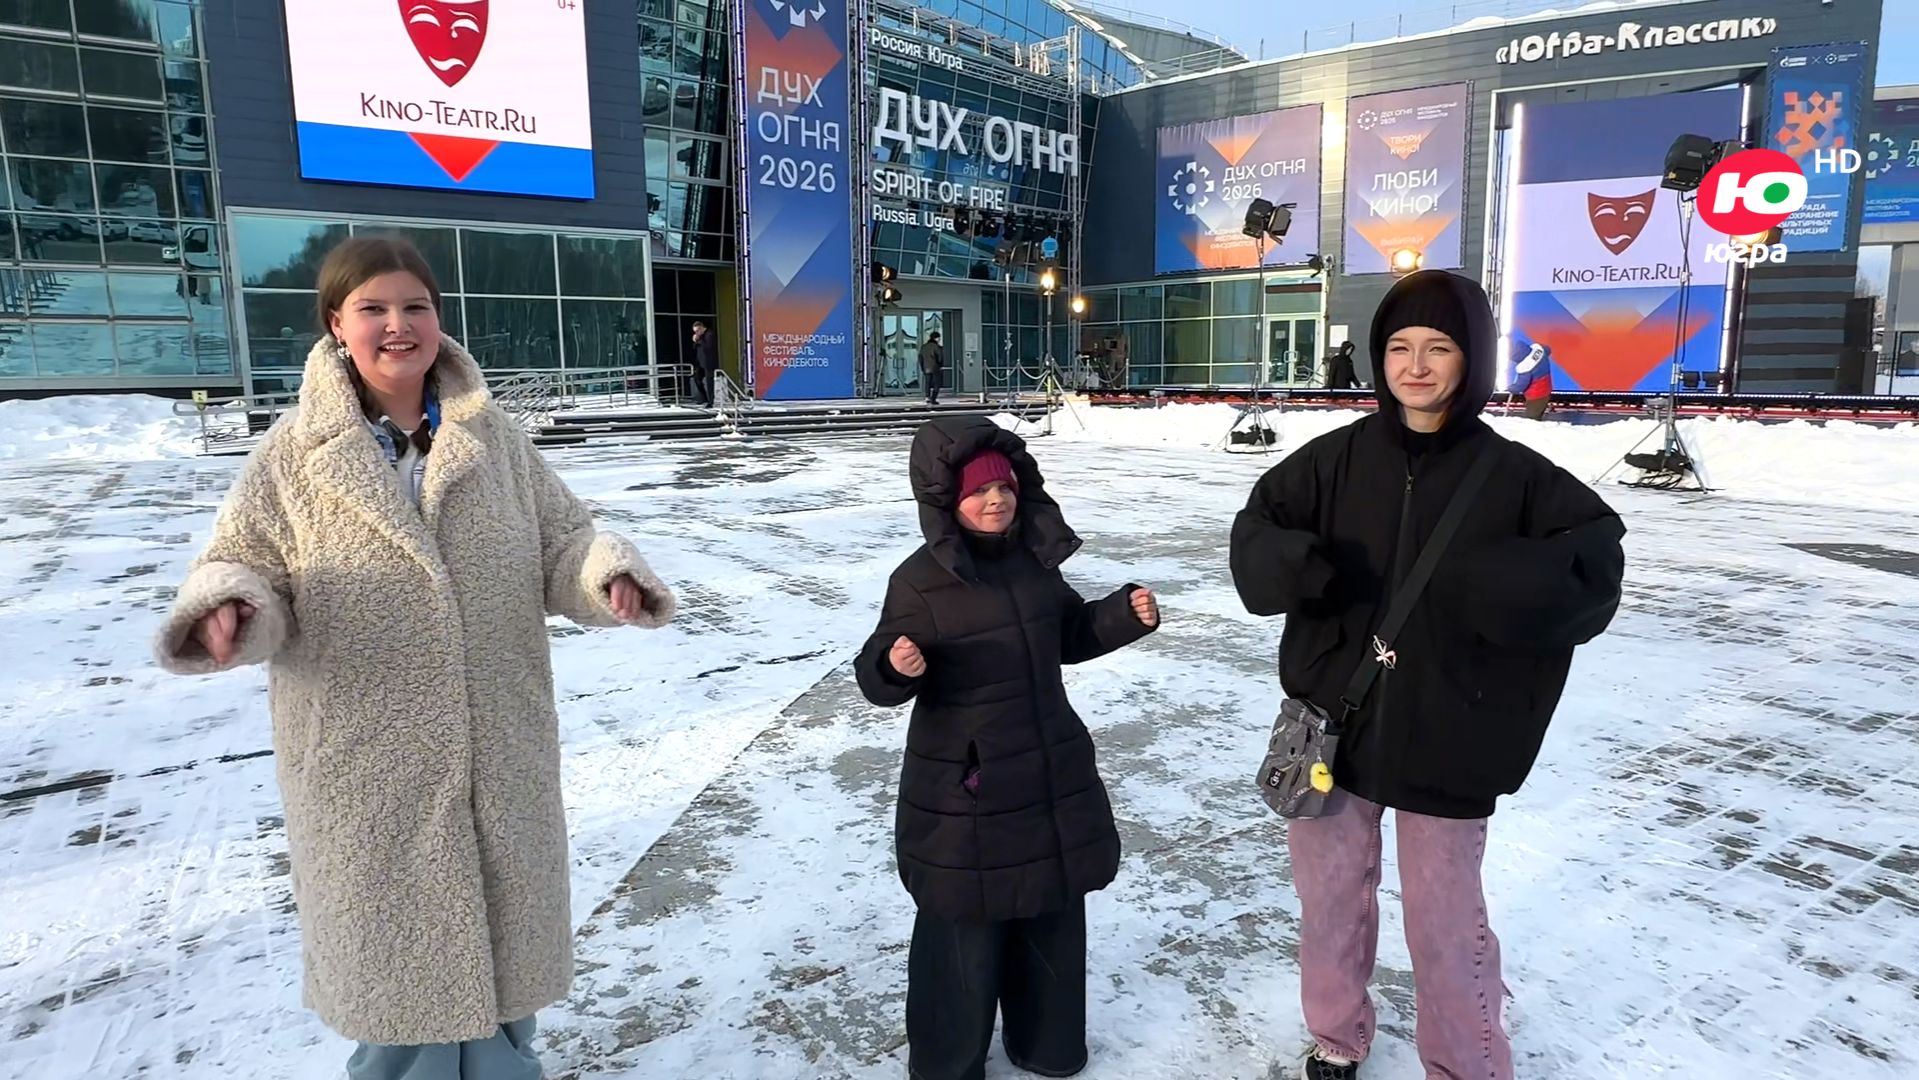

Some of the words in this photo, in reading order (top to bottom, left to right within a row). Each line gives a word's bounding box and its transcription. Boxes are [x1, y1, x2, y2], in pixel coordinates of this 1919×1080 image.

[871, 28, 924, 59] Россия.
[928, 48, 963, 70] Югра
[757, 66, 824, 108] ДУХ
[758, 111, 840, 153] ОГНЯ
[874, 87, 968, 155] ДУХ
[984, 116, 1079, 177] ОГНЯ
[759, 154, 836, 193] 2026
[1222, 164, 1257, 185] ДУХ
[1260, 158, 1306, 177] ОГНЯ
[1371, 168, 1438, 191] ЛЮБИ
[872, 169, 933, 200] SPIRIT
[939, 181, 964, 205] OF
[969, 186, 1004, 210] FIRE
[1222, 183, 1262, 201] 2026
[872, 204, 920, 226] Russia.
[924, 211, 955, 231] Ugra
[1369, 194, 1438, 217] КИНО!
[762, 332, 846, 345] МЕЖДУНАРОДНЫЙ
[763, 345, 816, 356] ФЕСТИВАЛЬ
[763, 357, 829, 369] КИНОДЕБЮТОВ
